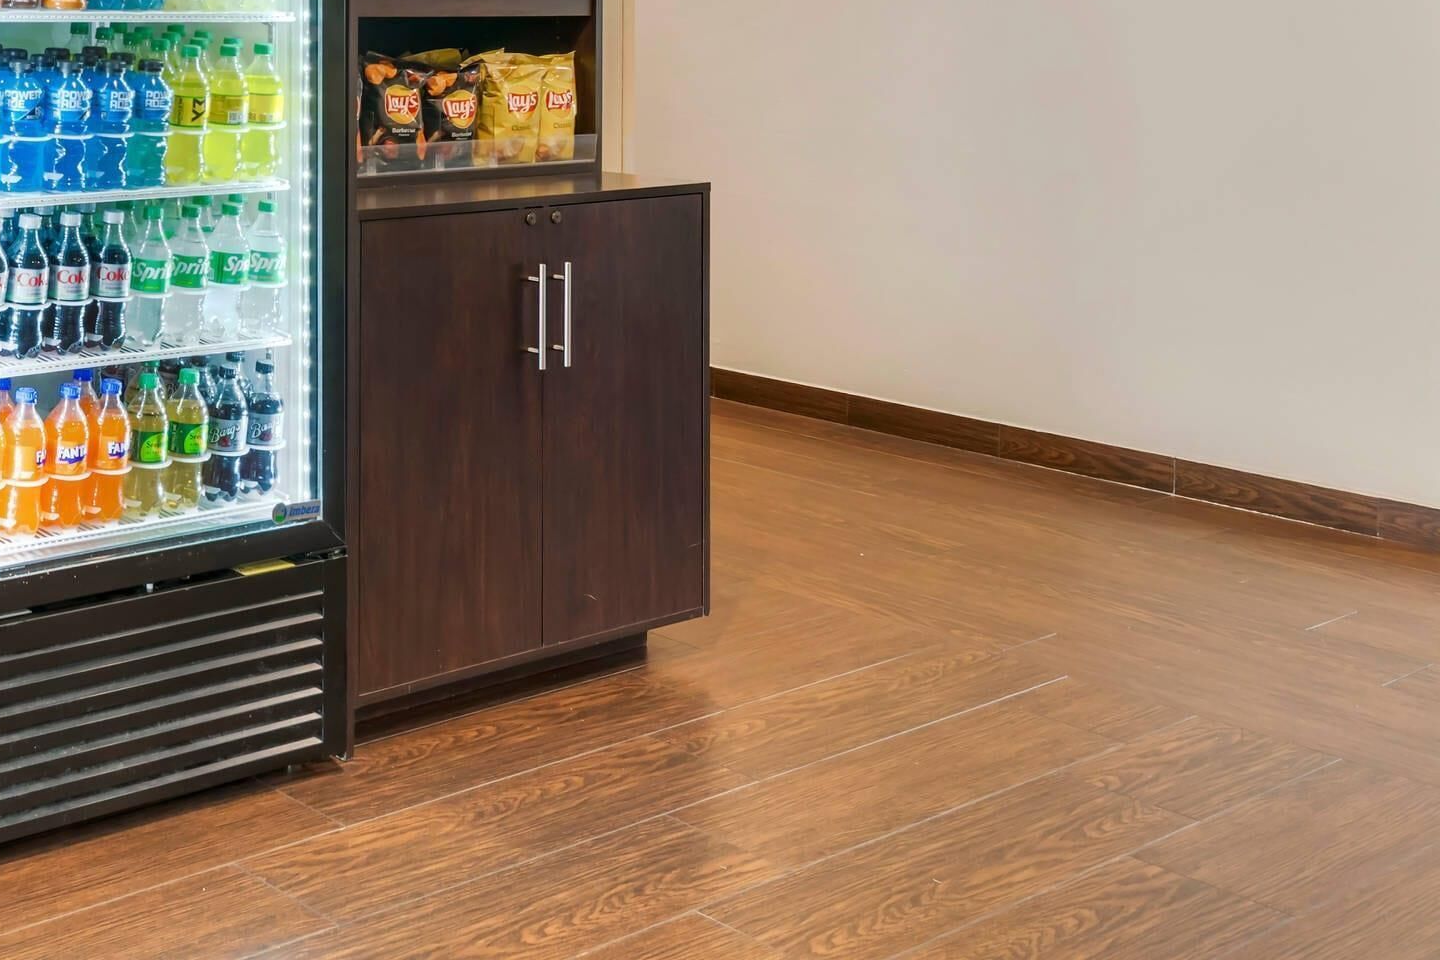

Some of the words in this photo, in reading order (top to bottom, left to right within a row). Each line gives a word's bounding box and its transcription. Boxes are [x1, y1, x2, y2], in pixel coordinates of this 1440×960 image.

[386, 92, 419, 114] Lay's
[446, 97, 476, 120] Lay's
[507, 92, 538, 112] Lay's
[545, 90, 574, 111] Lay's
[16, 271, 49, 288] Cok
[56, 269, 87, 286] Cok
[57, 443, 88, 461] FANT
